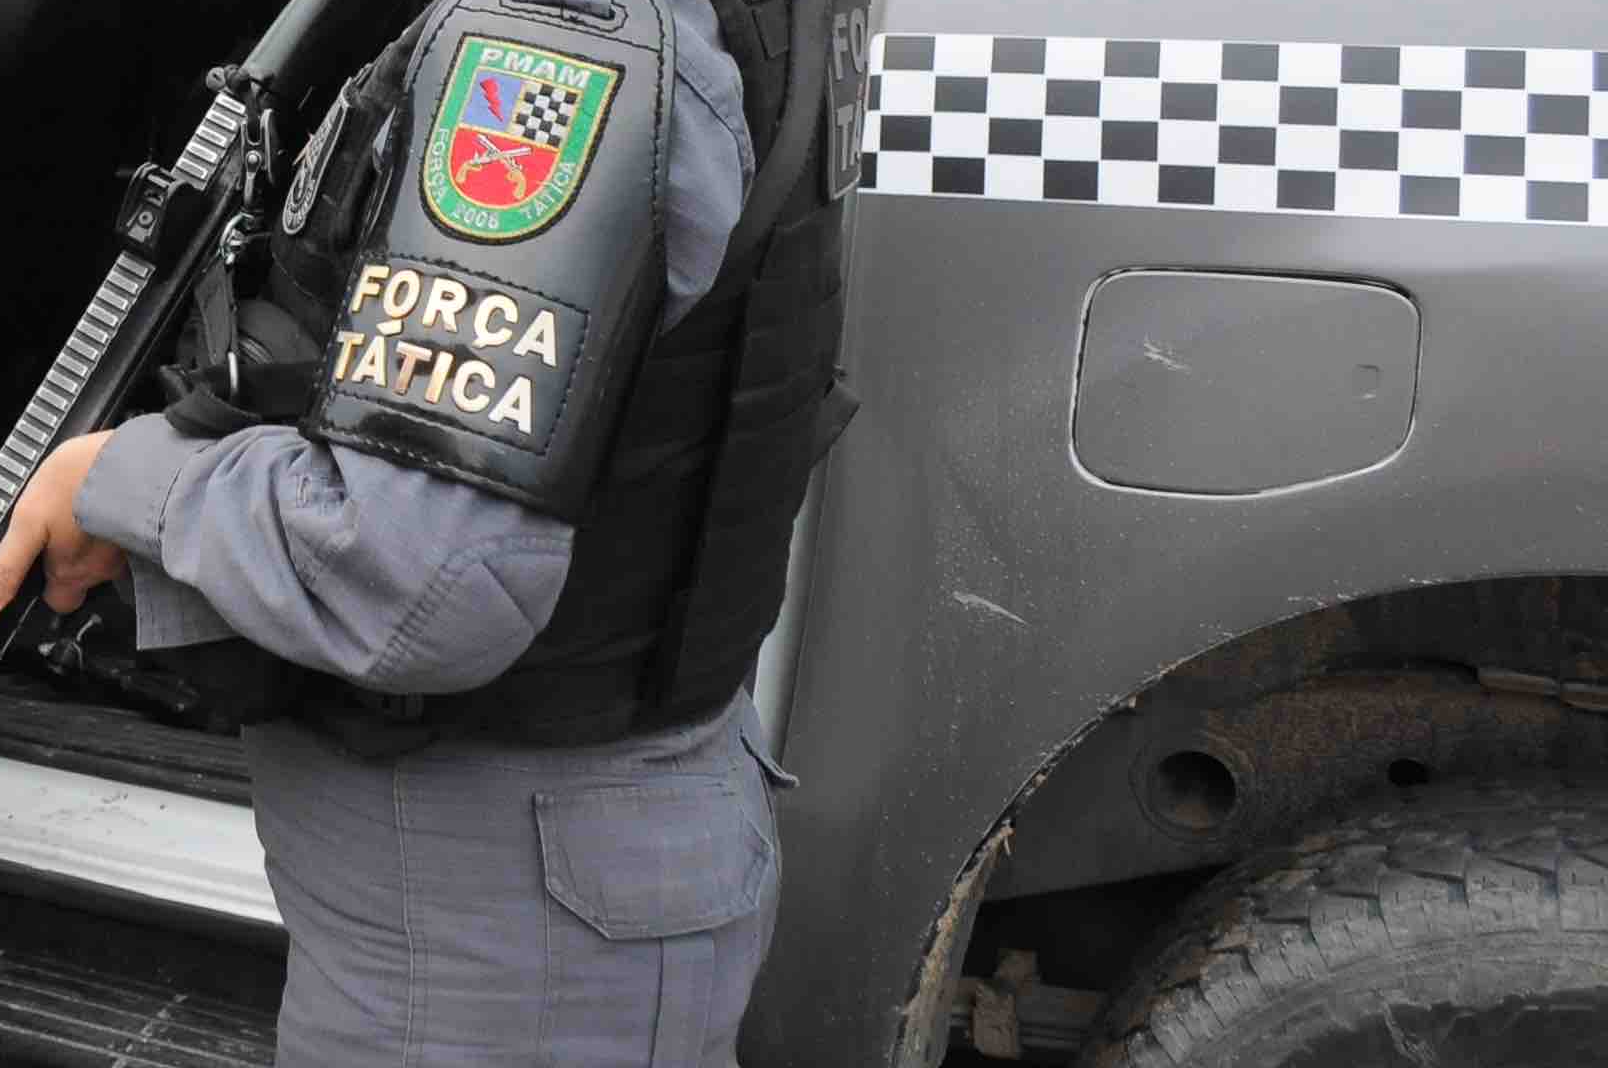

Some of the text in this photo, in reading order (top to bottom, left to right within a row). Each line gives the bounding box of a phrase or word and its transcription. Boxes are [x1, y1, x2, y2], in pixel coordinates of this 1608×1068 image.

[479, 47, 591, 89] PMAM
[350, 263, 559, 368] FORÇA
[333, 319, 533, 435] TÁTICA
